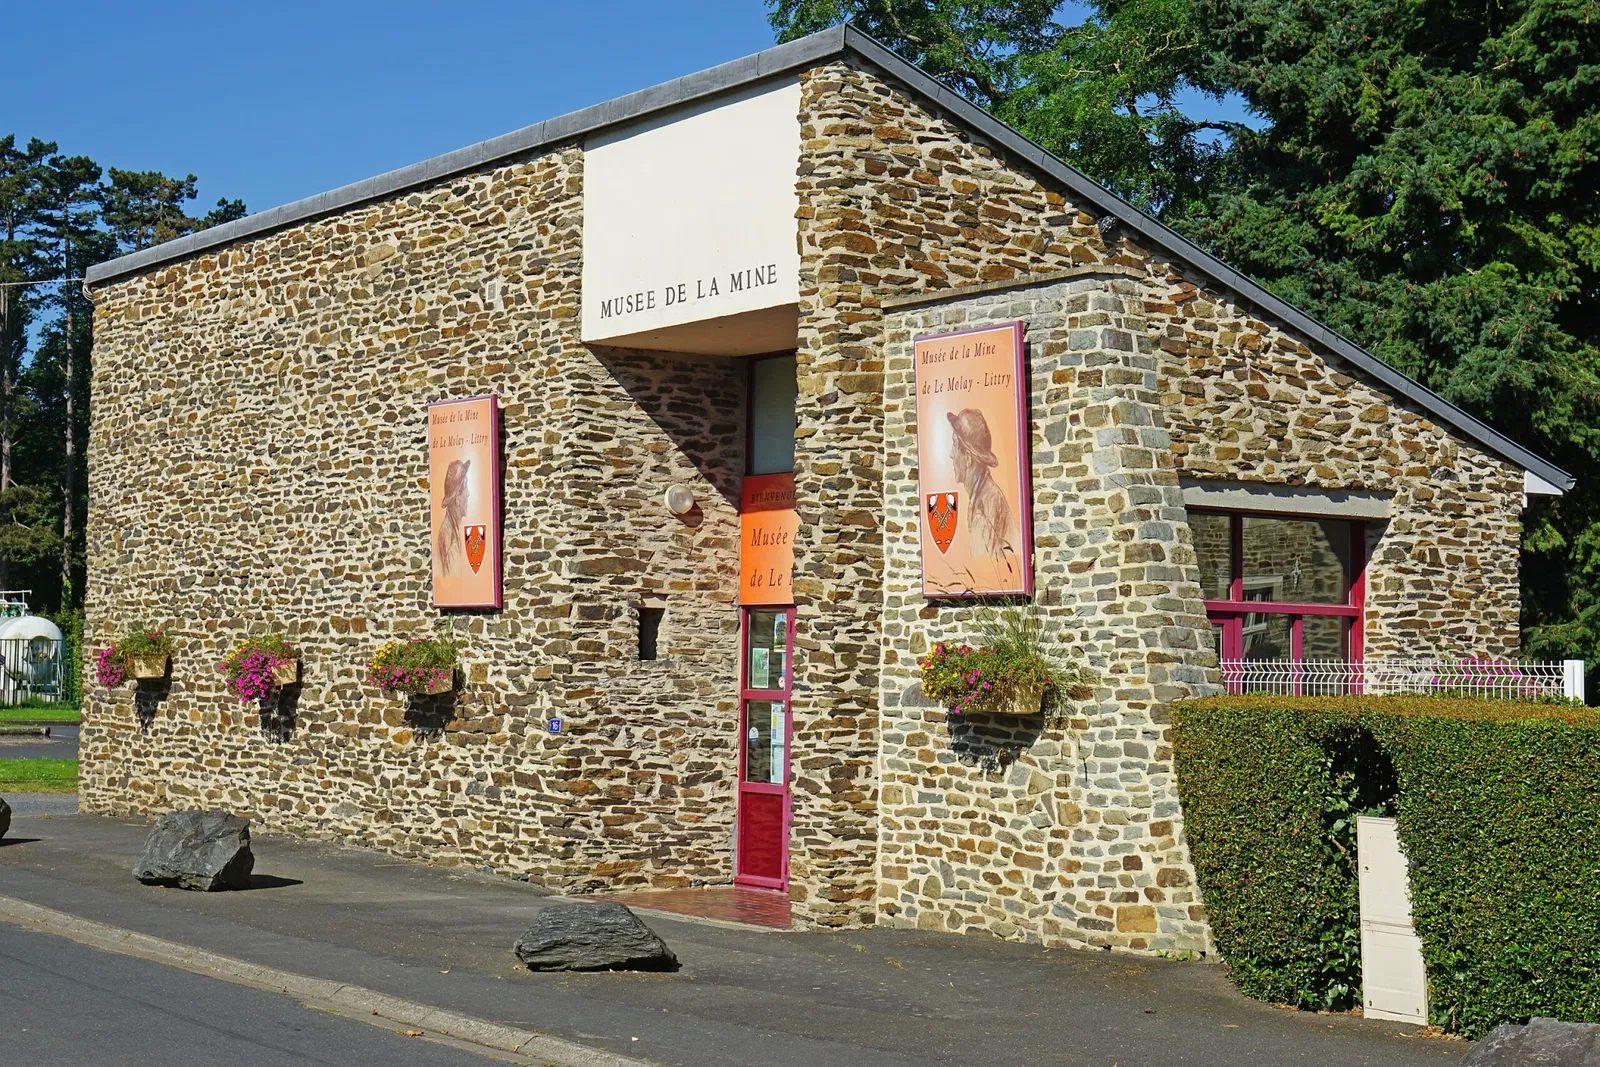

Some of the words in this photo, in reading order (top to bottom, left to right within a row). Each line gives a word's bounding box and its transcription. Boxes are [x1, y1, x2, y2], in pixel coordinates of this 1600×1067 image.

[600, 290, 656, 319] MUSEE
[665, 283, 687, 306] DE
[696, 276, 720, 299] LA
[729, 263, 778, 293] MINE
[921, 348, 946, 365] Musée
[949, 346, 959, 361] de
[962, 344, 970, 359] la
[974, 342, 996, 358] Mine
[922, 380, 931, 395] de
[934, 379, 943, 394] Le
[947, 376, 973, 393] Molay
[984, 372, 1012, 388] Littry
[431, 412, 448, 426] Musée
[449, 411, 456, 423] de
[457, 410, 463, 422] la
[465, 409, 479, 421] Mine
[432, 437, 439, 449] de
[440, 436, 446, 448] Le
[448, 434, 464, 449] Molay
[470, 433, 489, 446] Littry
[750, 526, 788, 547] Musée
[750, 568, 763, 588] de
[768, 568, 783, 587] Le
